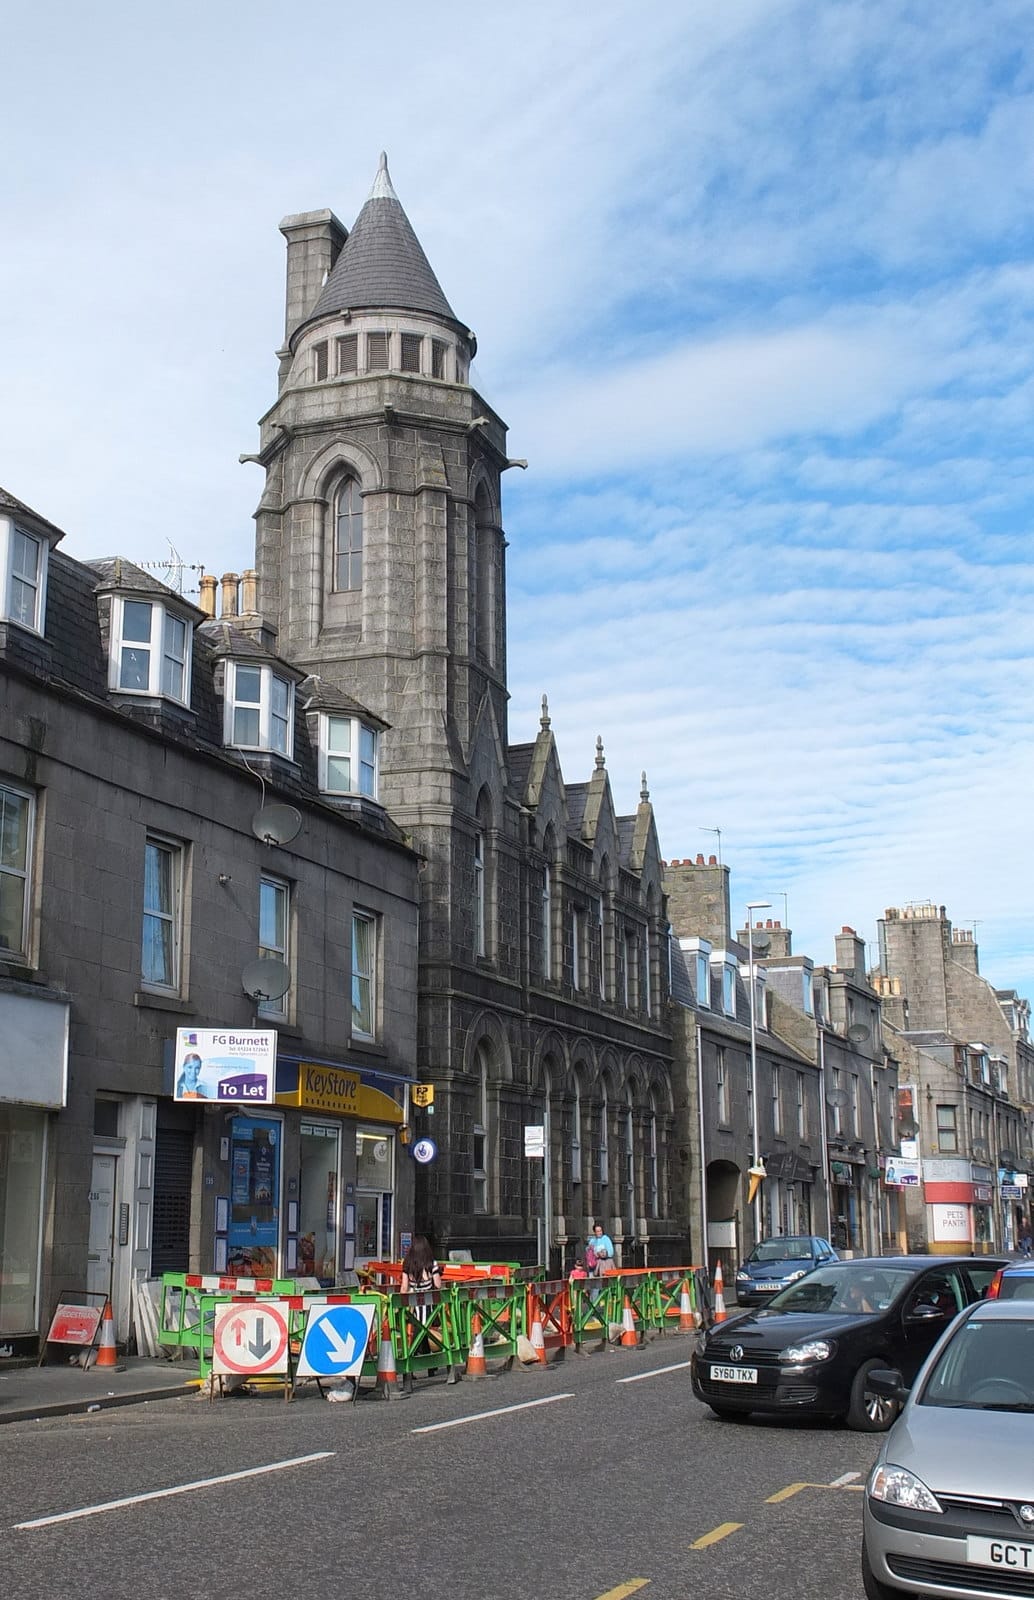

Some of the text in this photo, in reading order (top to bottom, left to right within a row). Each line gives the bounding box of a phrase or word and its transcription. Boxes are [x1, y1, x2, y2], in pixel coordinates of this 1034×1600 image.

[212, 1035, 269, 1046] FG Burnett
[220, 1083, 264, 1096] To Let
[305, 1068, 357, 1099] KeyStore
[946, 1210, 964, 1219] PETS
[942, 1218, 967, 1228] PANTRY
[713, 1367, 754, 1381] SY60 TKX
[990, 1542, 1033, 1568] GCT
